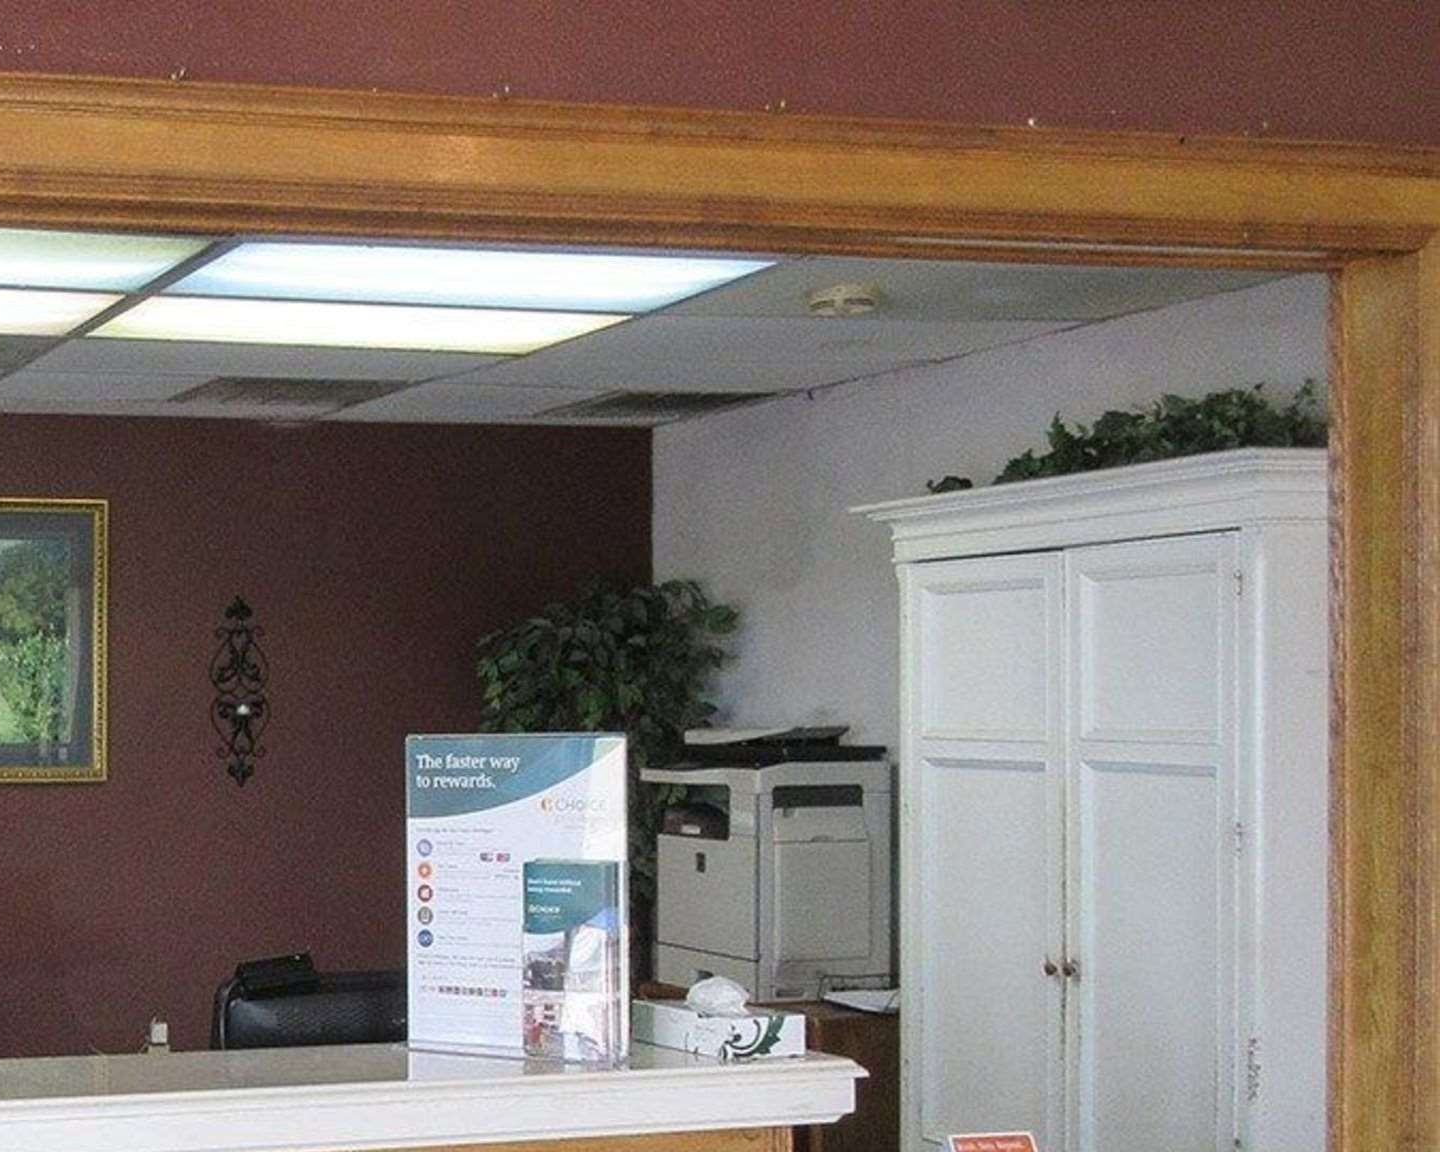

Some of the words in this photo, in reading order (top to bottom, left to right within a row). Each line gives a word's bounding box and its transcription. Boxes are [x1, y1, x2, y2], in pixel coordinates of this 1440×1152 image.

[416, 753, 443, 769] The
[446, 753, 488, 769] faster
[490, 756, 521, 773] way
[416, 774, 431, 789] to
[433, 773, 497, 790] rewards.
[555, 799, 607, 812] CHOCE
